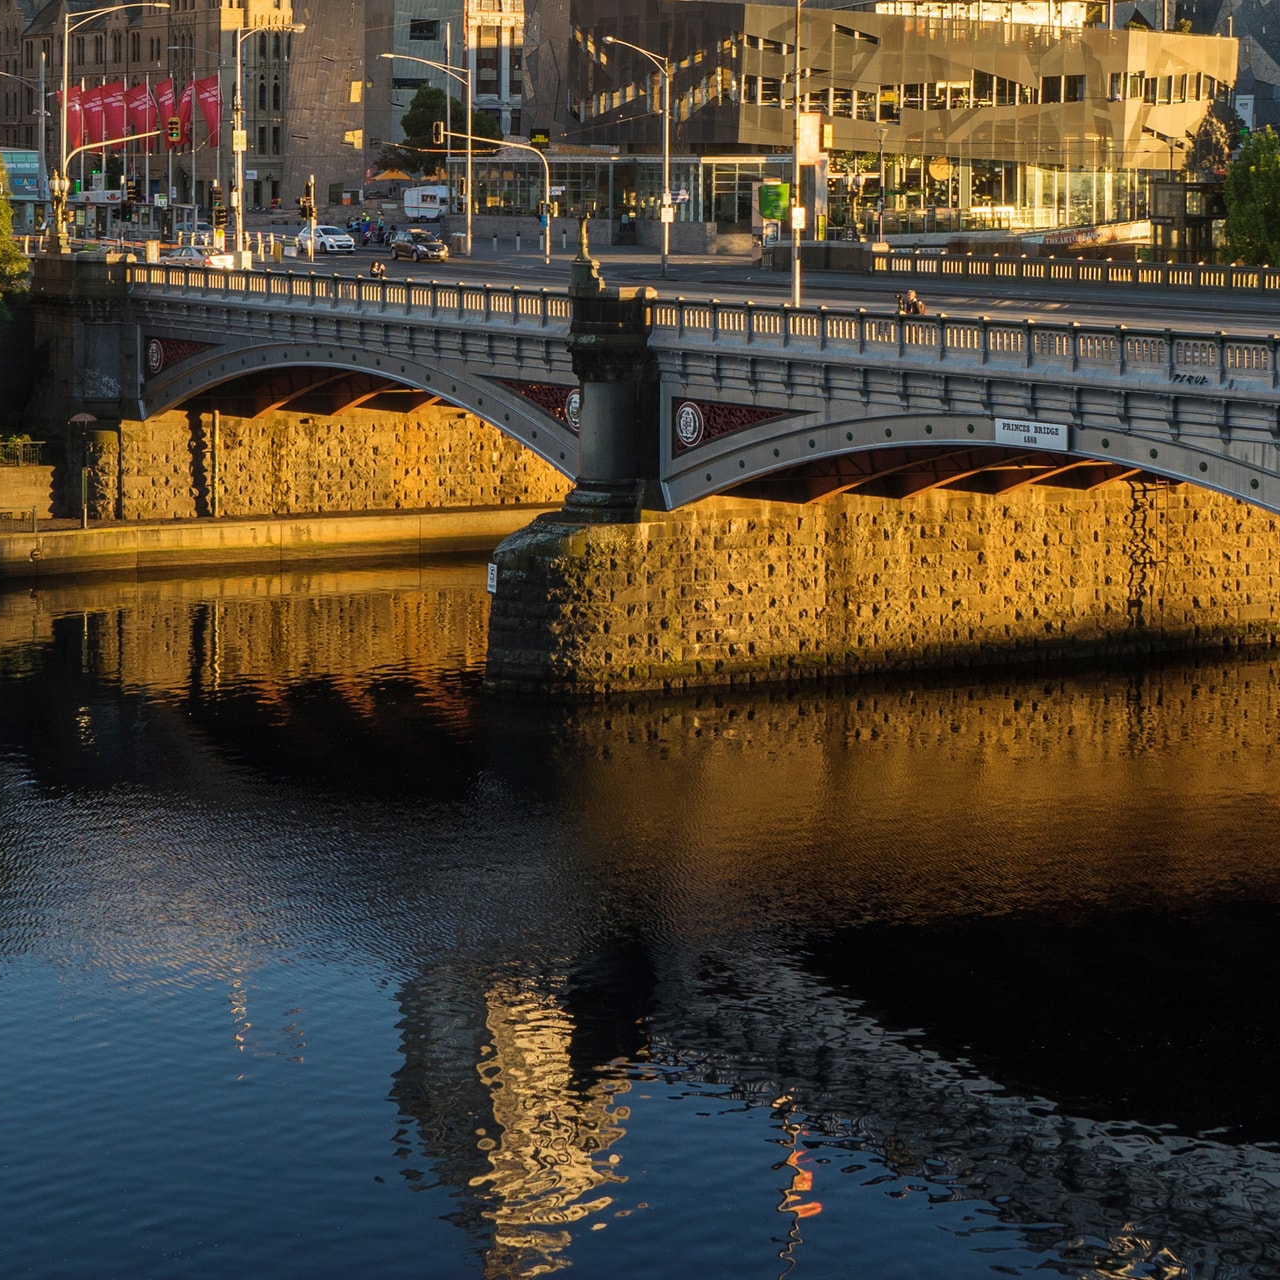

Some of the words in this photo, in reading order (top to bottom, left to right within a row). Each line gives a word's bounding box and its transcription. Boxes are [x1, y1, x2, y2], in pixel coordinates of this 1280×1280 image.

[1002, 423, 1030, 433] PRINCES
[1034, 426, 1059, 436] BRIDGE
[1023, 436, 1037, 444] 1888
